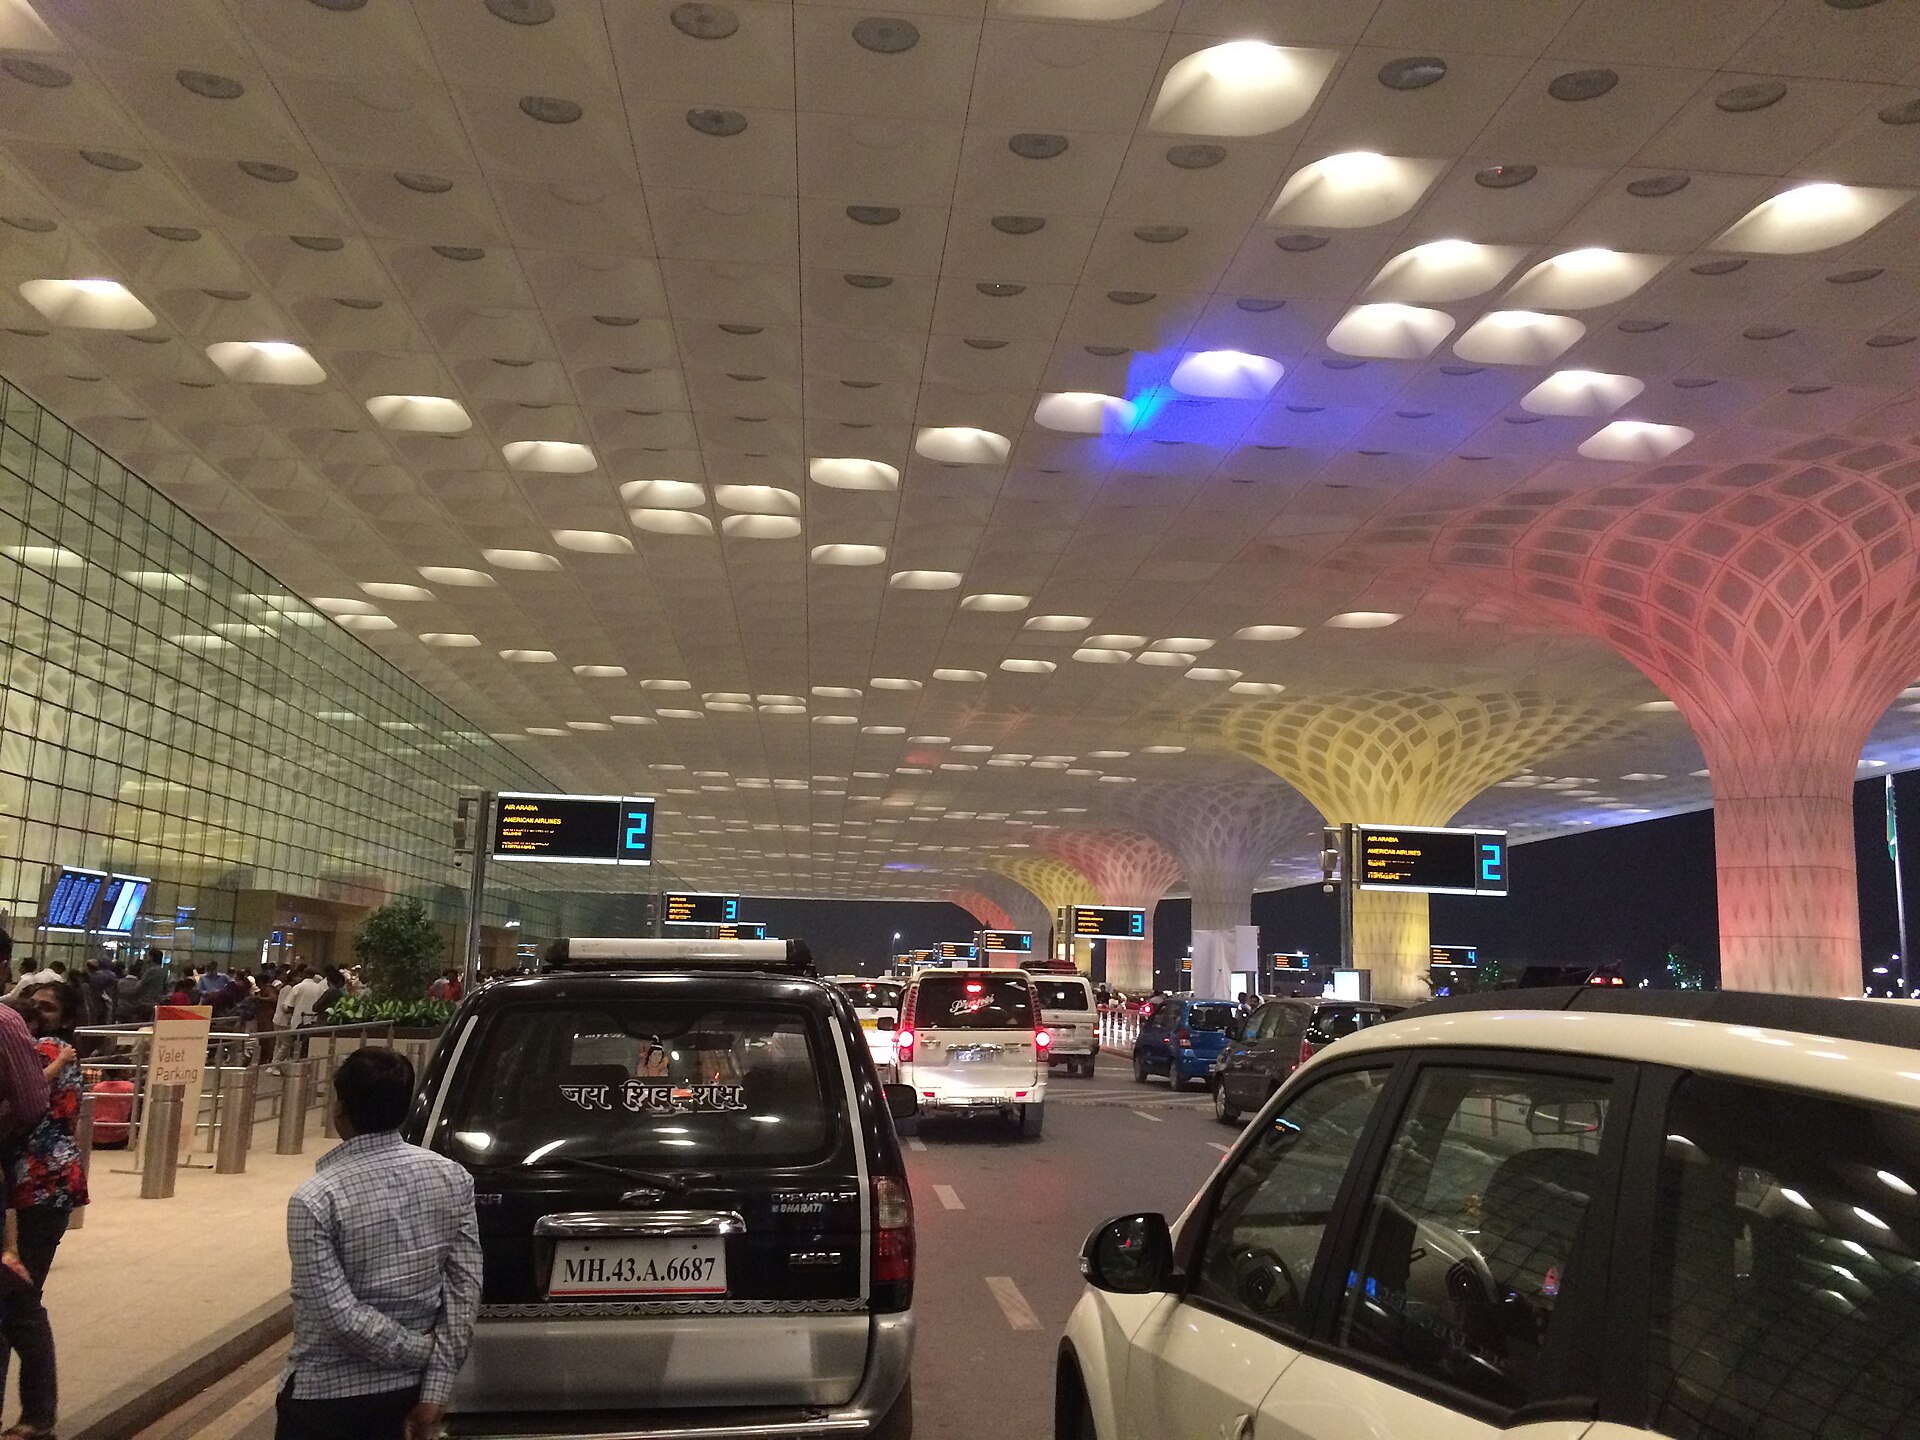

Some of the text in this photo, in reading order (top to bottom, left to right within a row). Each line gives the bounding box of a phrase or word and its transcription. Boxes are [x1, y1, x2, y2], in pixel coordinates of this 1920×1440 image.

[502, 816, 534, 824] AMERICAN
[626, 812, 648, 849] 2
[1481, 844, 1501, 880] 2
[725, 900, 737, 919] 3
[1131, 914, 1142, 933] 3
[756, 927, 764, 940] 4
[1022, 935, 1030, 949] 4
[1302, 957, 1308, 968] 5
[1467, 951, 1475, 964] 4
[158, 1049, 185, 1063] Valet
[156, 1066, 198, 1083] Parking
[559, 1084, 612, 1110] जय
[771, 1192, 857, 1202] CHEVROLET
[780, 1203, 823, 1213] BHARATI
[563, 1257, 716, 1283] MH.43.A.6687
